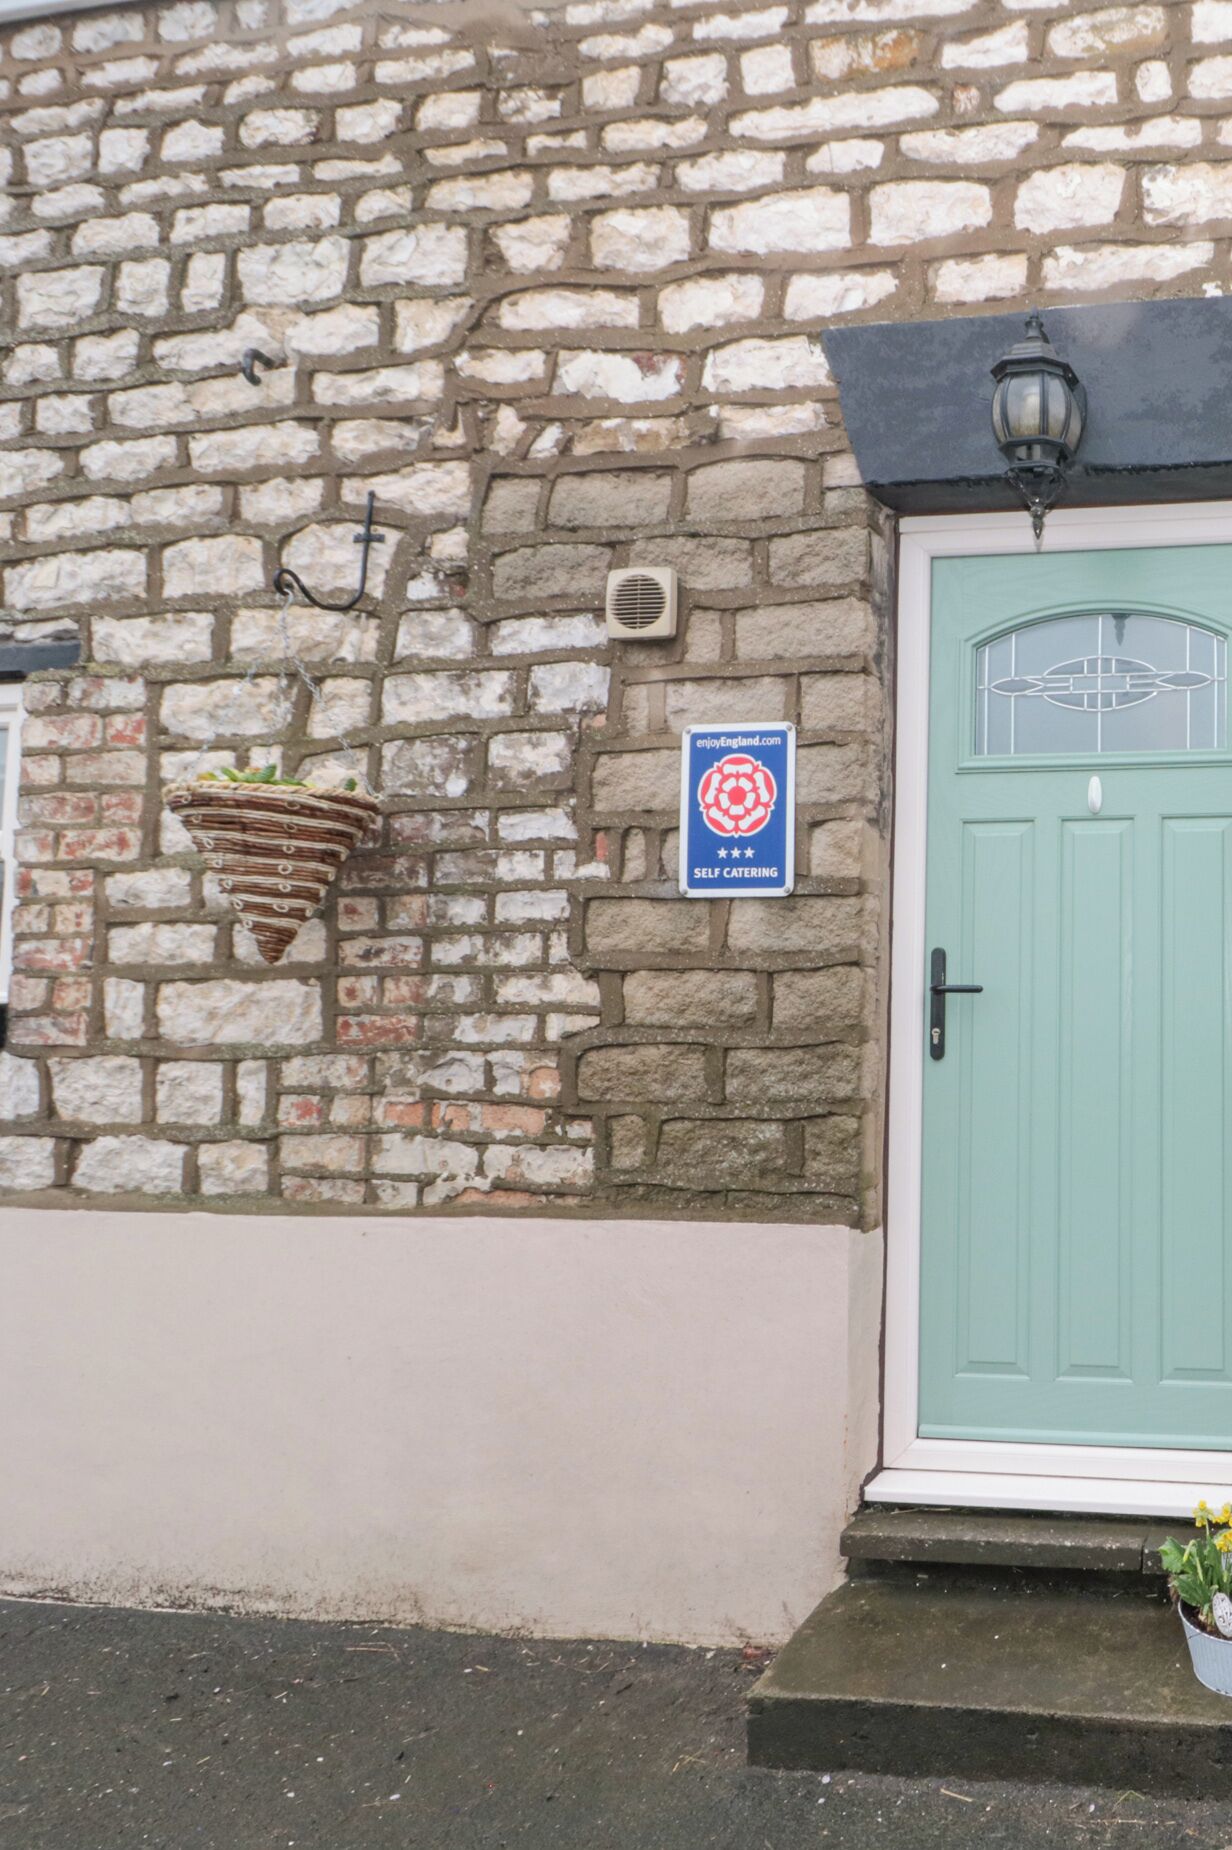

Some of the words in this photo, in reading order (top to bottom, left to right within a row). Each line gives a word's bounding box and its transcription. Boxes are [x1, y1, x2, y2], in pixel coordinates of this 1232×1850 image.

[696, 735, 781, 749] enjoyEngland.com
[693, 867, 721, 878] SELF
[723, 867, 778, 878] CATERING
